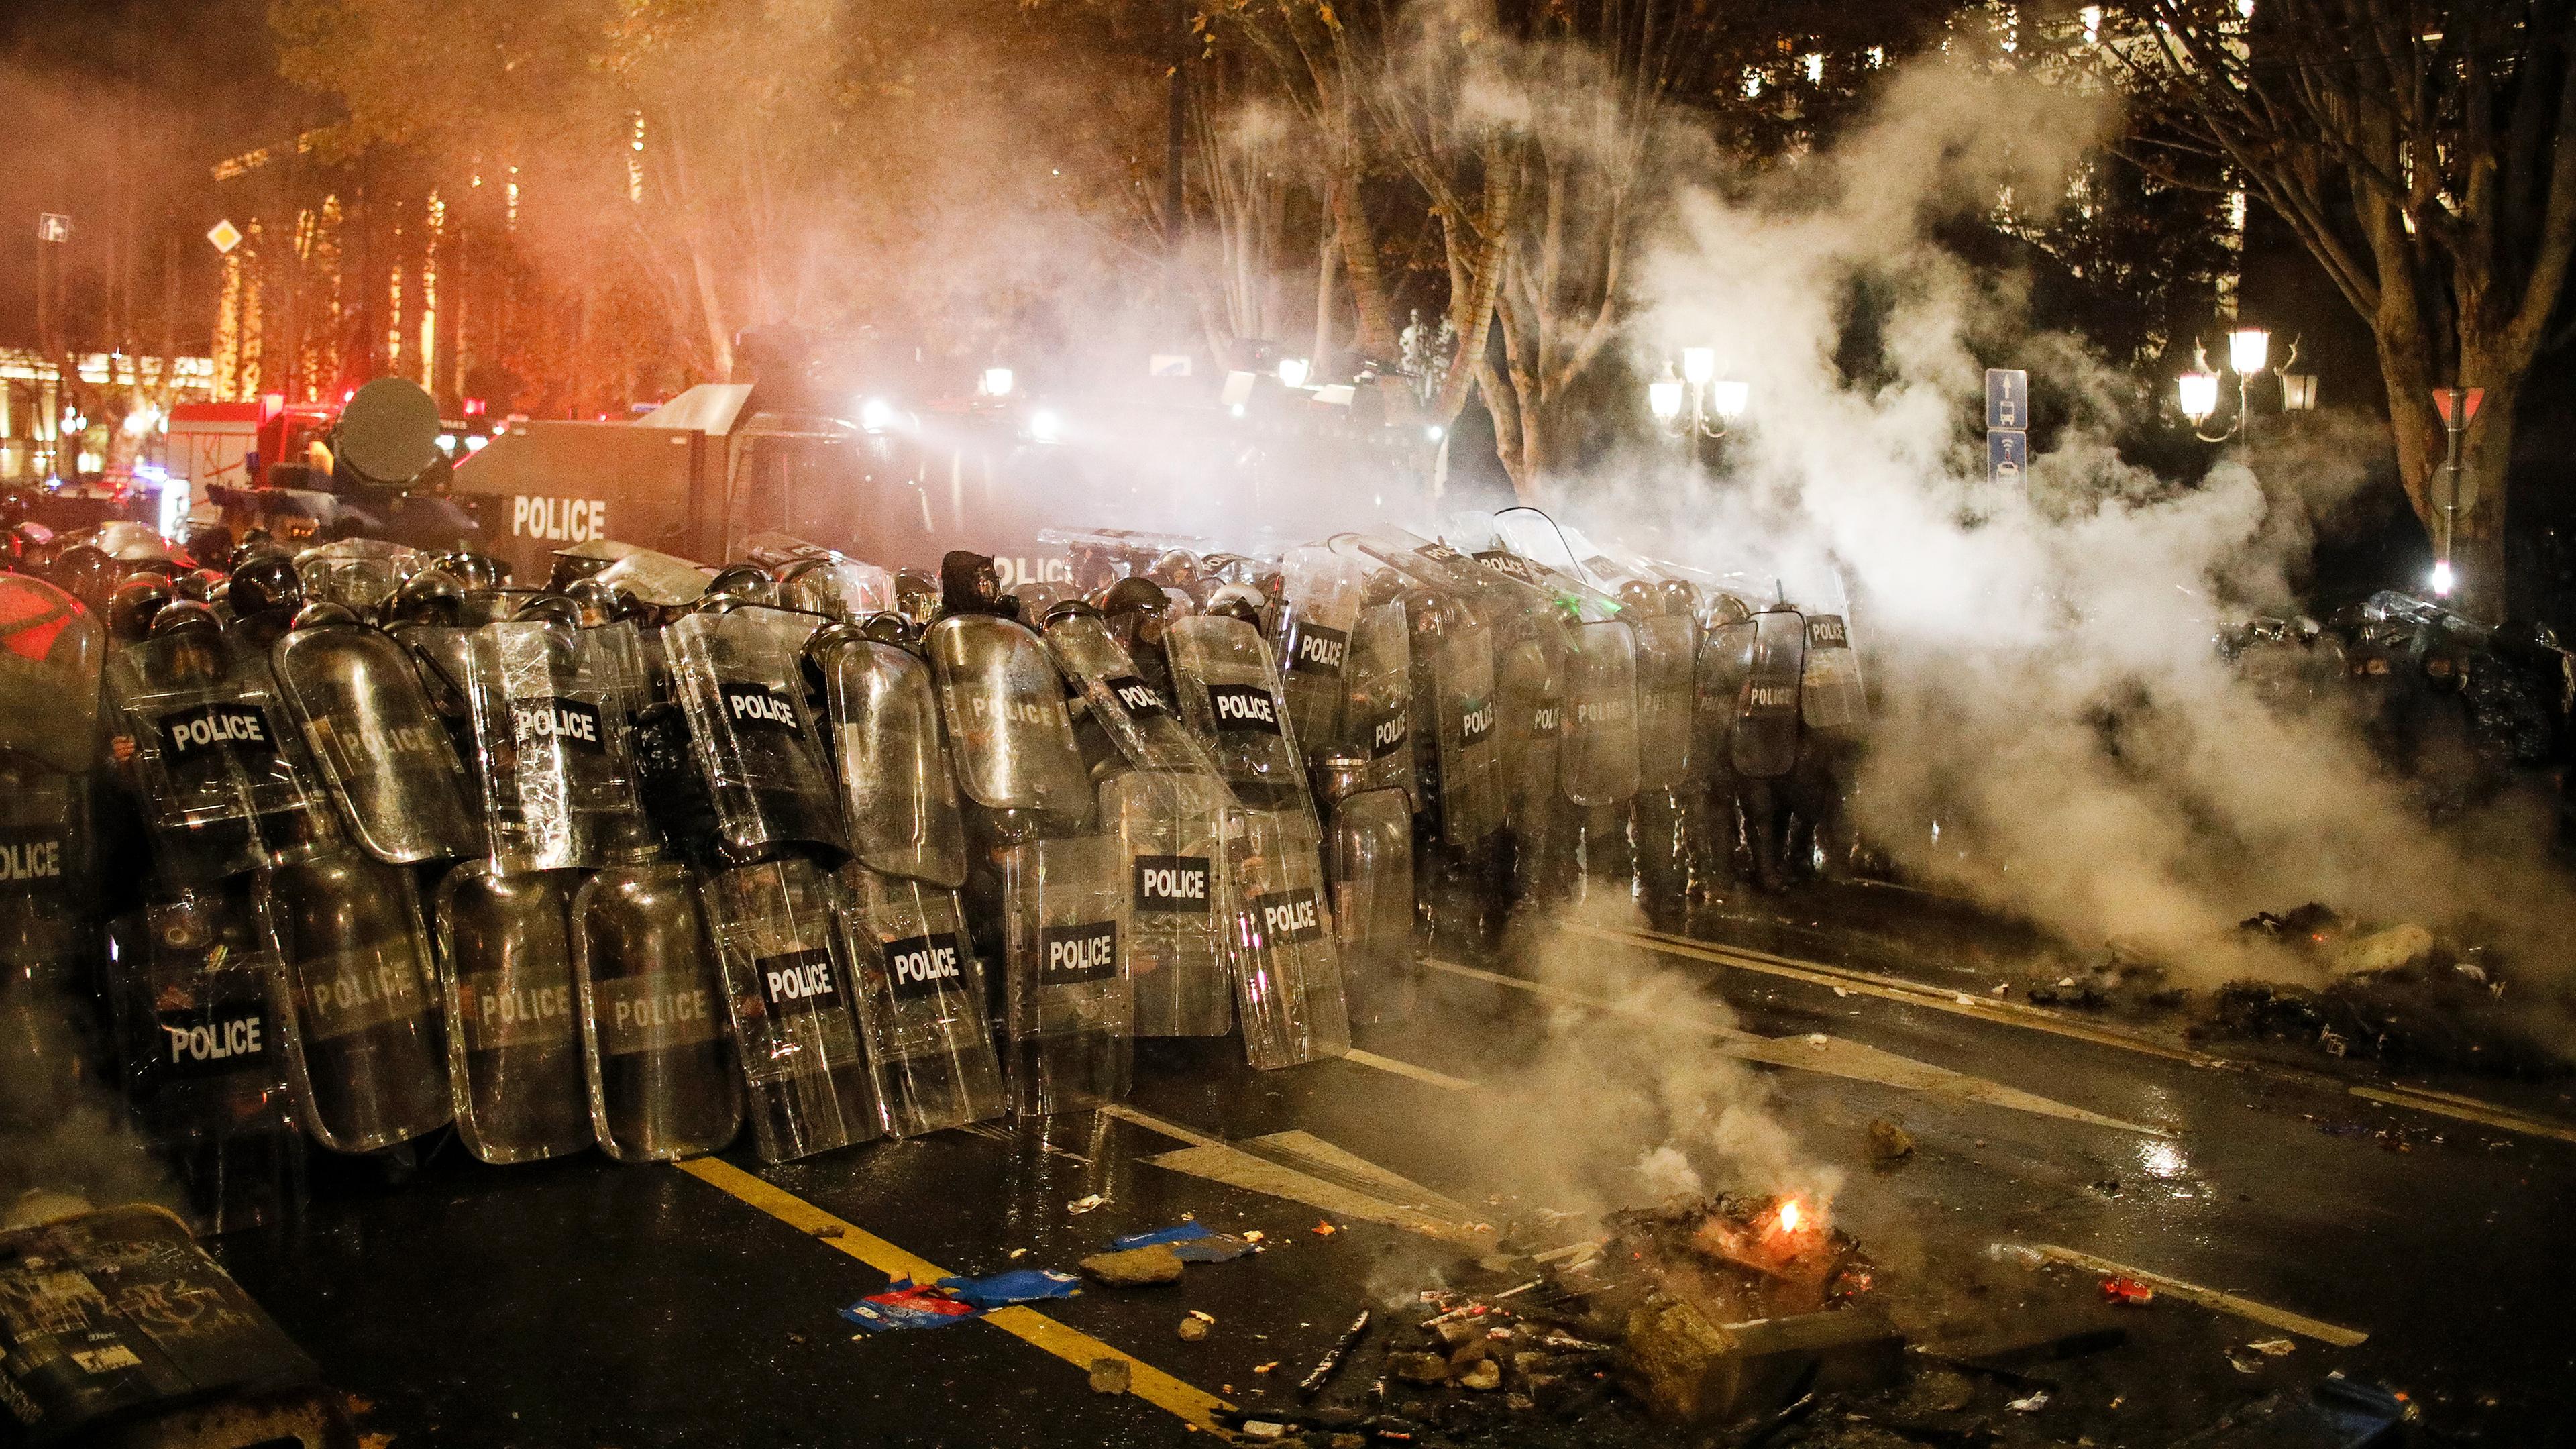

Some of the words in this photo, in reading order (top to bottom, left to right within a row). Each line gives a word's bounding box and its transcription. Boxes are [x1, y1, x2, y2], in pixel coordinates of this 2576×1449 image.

[513, 495, 606, 542] POLICE
[1300, 635, 1343, 667] POLICE
[515, 708, 596, 742] POLICE
[730, 695, 797, 729] POLICE
[1217, 695, 1274, 723] POLICE
[172, 714, 264, 751] POLICE
[0, 841, 60, 881] OLICE
[1144, 869, 1205, 899] POLICE
[1265, 900, 1316, 934] POLICE
[894, 947, 959, 985] POLICE
[1050, 935, 1111, 971] POLICE
[313, 961, 413, 1016] POLICE
[767, 963, 833, 1004] POLICE
[482, 985, 570, 1026] POLICE
[615, 989, 707, 1031] POLICE
[170, 1016, 262, 1063] POLICE
